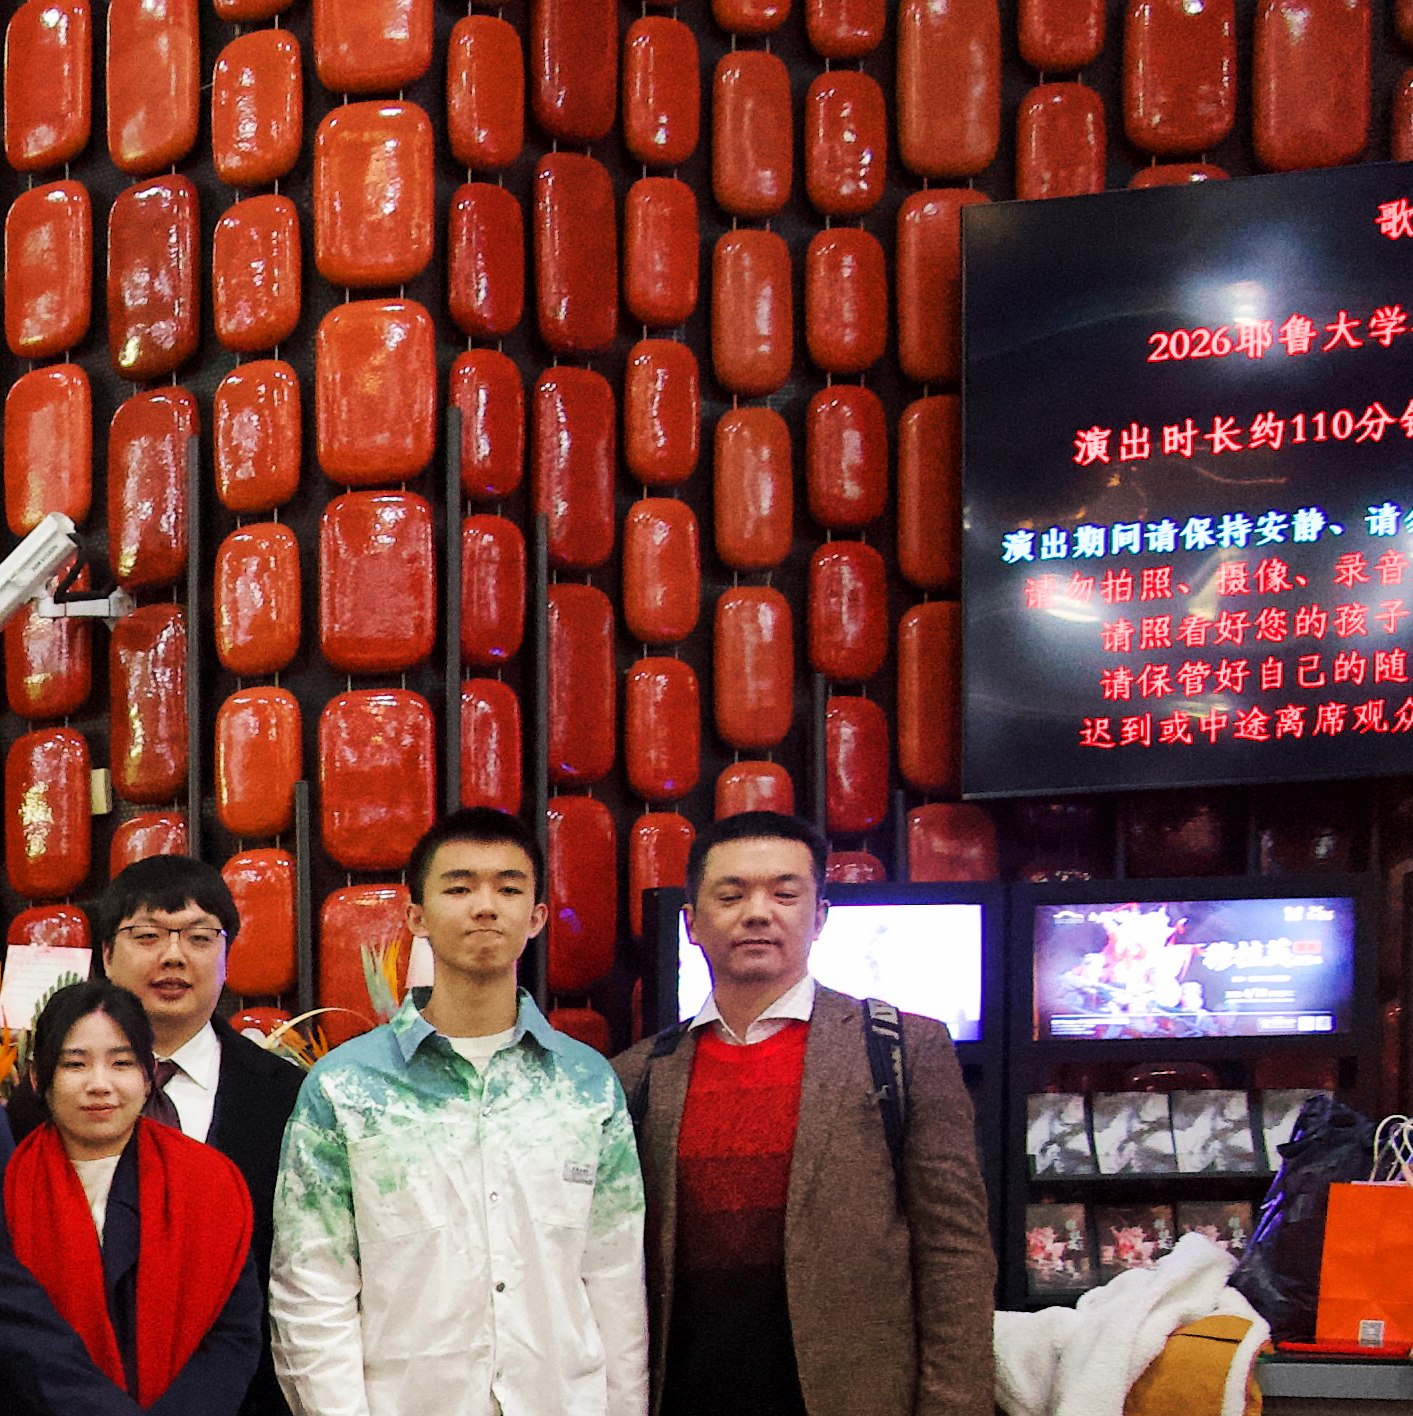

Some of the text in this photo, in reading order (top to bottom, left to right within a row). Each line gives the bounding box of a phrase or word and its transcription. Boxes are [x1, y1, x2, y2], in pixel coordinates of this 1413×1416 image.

[1146, 303, 1413, 363] 2026耶鲁大学
[1001, 501, 1413, 565] 演出期间请保持安静、请
[1099, 597, 1410, 654] 请照看好您的孩子
[1099, 647, 1409, 702] 请保管好自己的随
